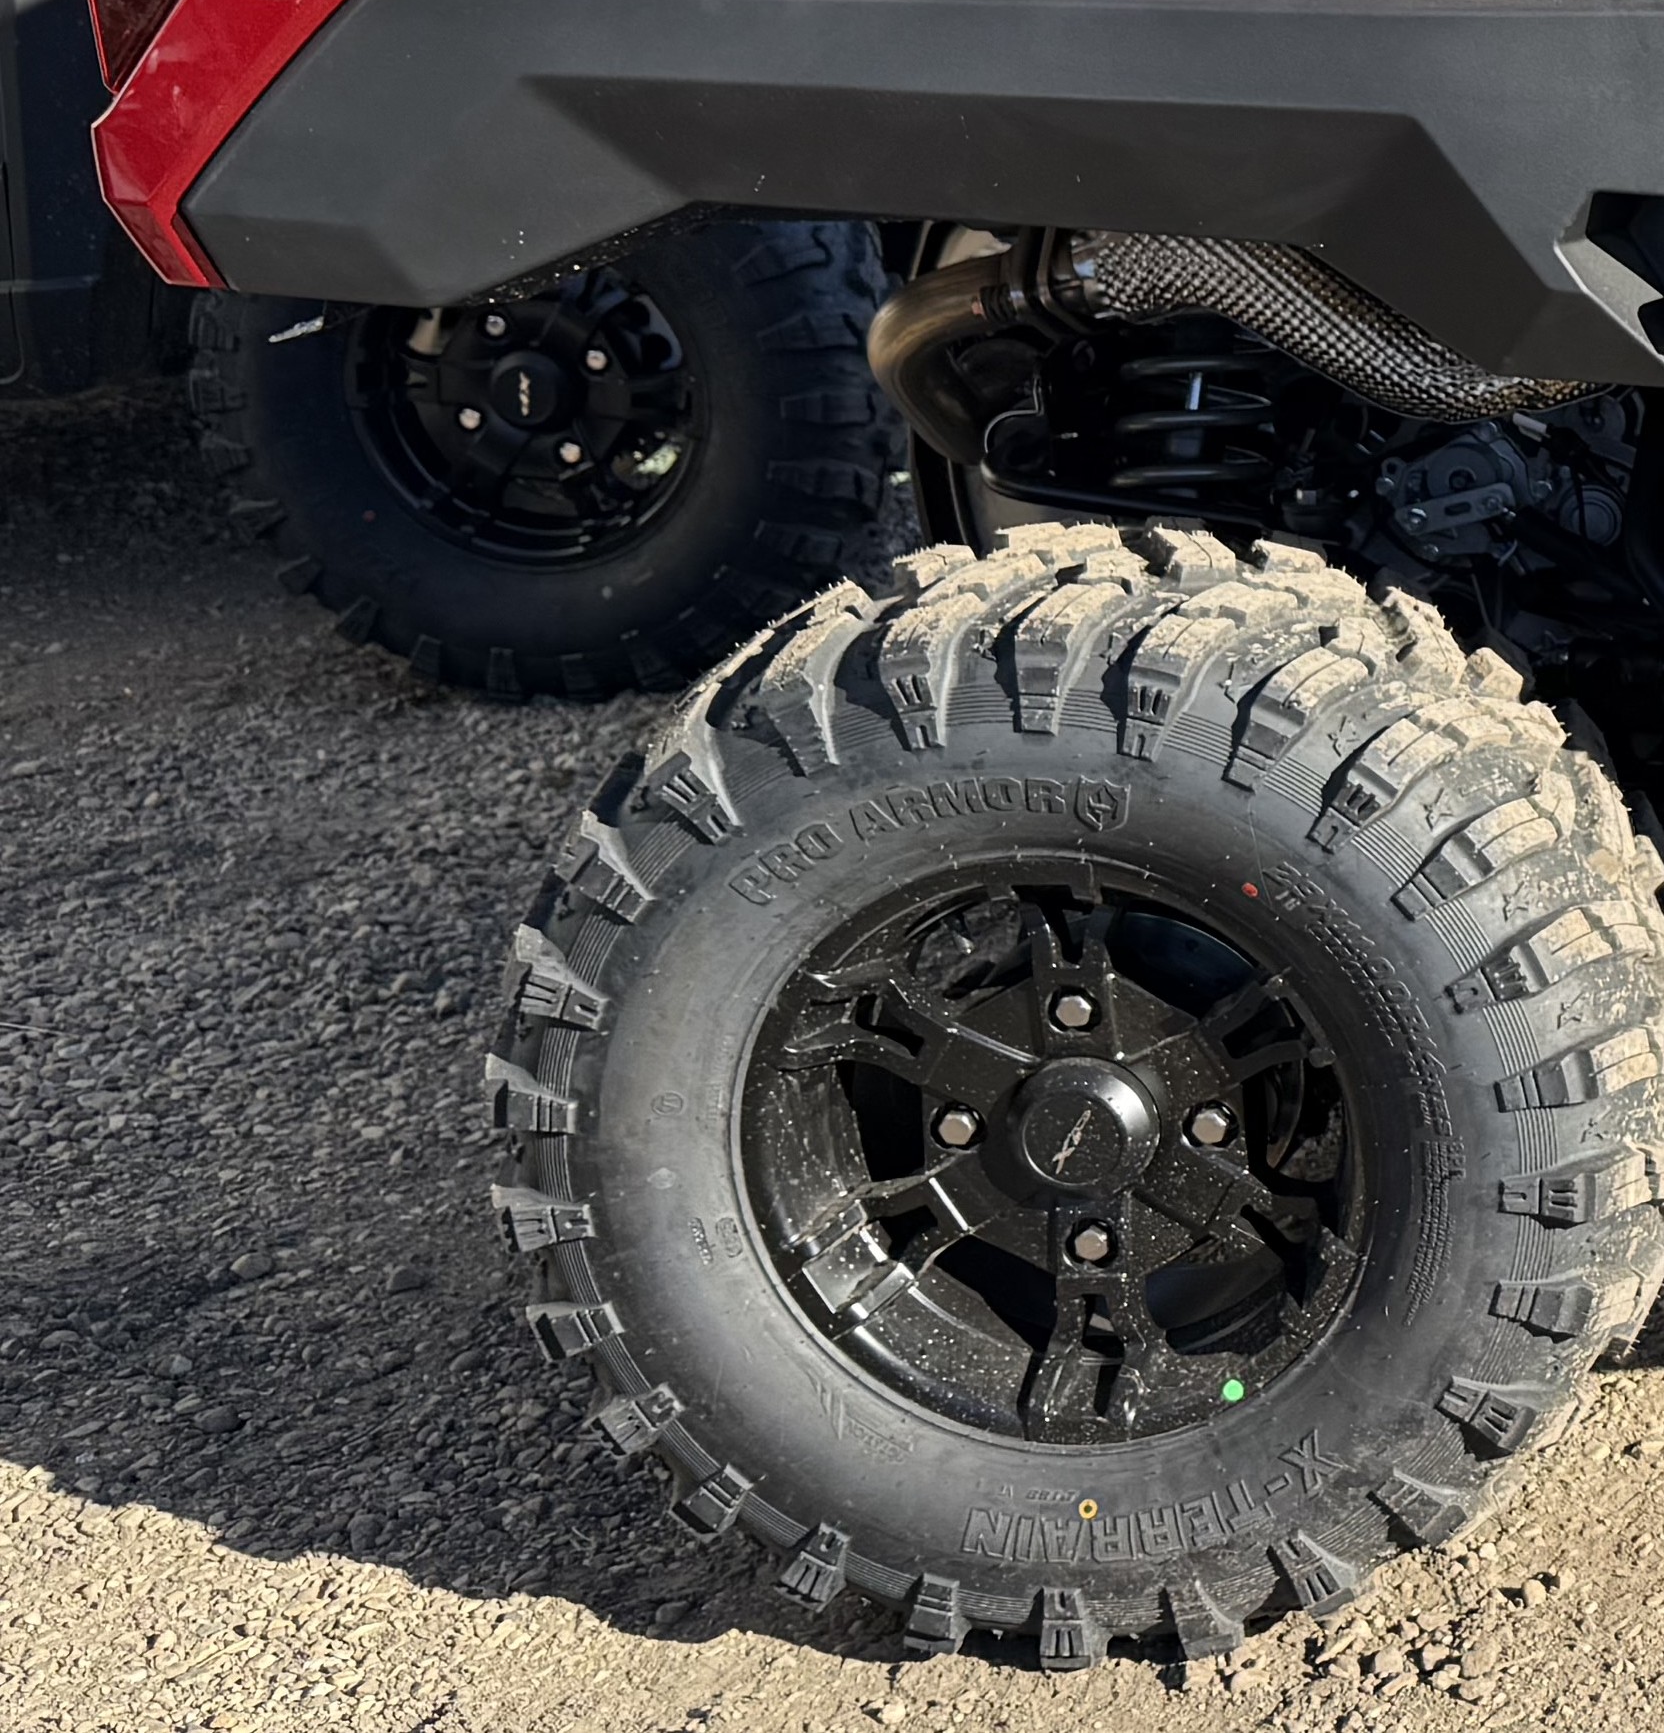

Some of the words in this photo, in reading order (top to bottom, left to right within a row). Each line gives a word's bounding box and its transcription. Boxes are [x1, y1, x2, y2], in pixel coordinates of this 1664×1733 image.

[727, 822, 845, 906] PRO
[848, 775, 1069, 842] ARMOR
[960, 1427, 1343, 1565] X-TERRAIN
